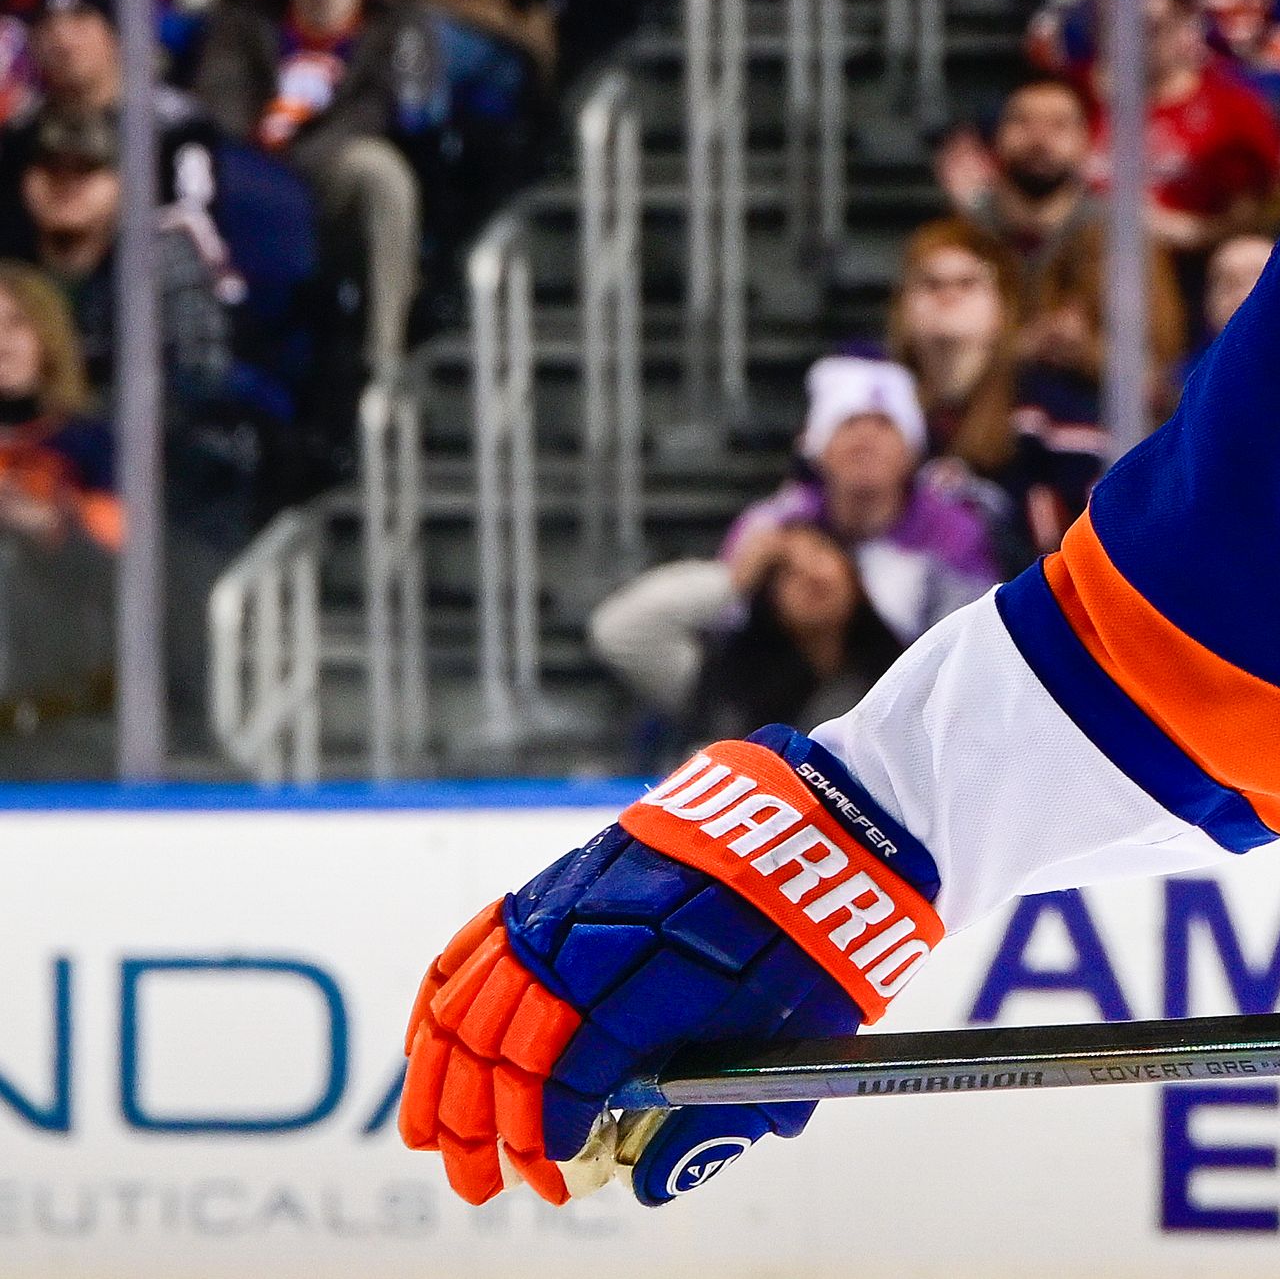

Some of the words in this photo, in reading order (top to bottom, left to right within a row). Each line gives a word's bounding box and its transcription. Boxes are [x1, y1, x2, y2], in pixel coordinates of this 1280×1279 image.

[798, 762, 898, 858] SCHAEFER
[856, 1068, 1044, 1096] WARRIOR
[1087, 1062, 1194, 1082] COVERT
[0, 1177, 437, 1238] UTICALS
